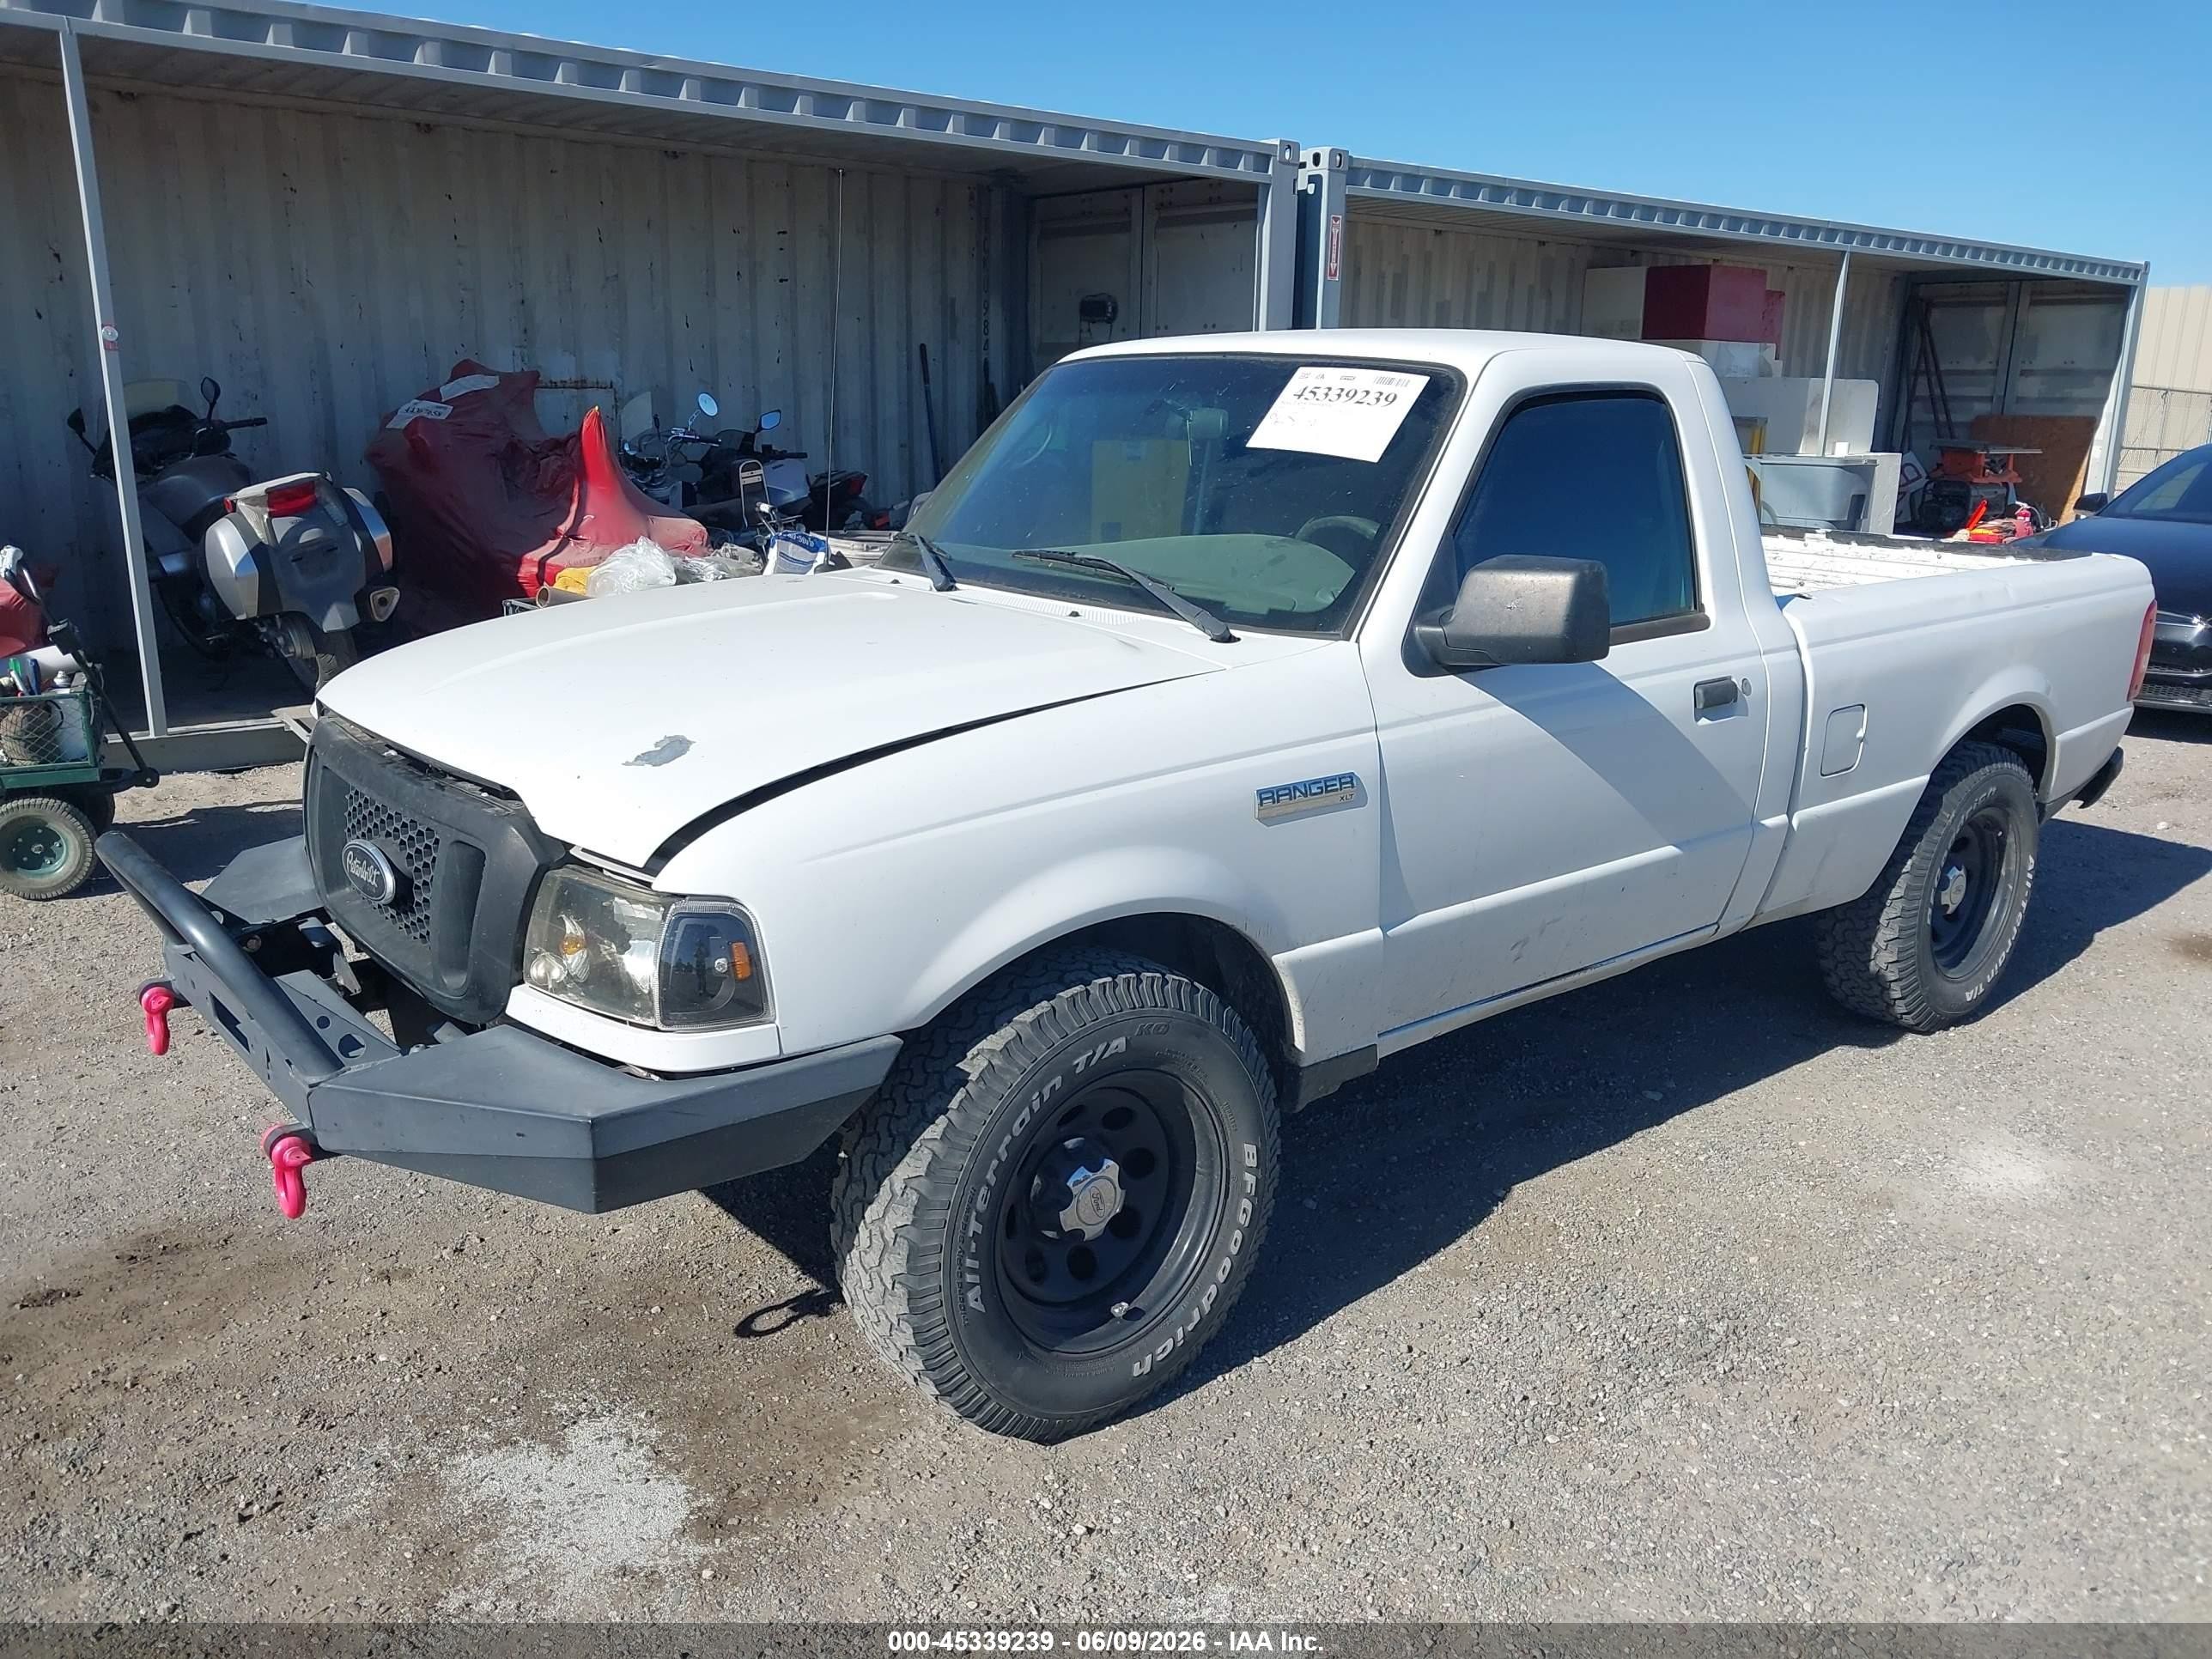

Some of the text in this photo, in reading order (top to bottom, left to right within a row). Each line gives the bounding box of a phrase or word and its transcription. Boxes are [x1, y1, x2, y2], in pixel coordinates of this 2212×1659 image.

[1292, 385, 1398, 408] 45339239
[1258, 774, 1356, 808] RANGER
[1338, 793, 1355, 803] XLT
[346, 850, 380, 888] Peterbilt
[1965, 854, 2035, 1002] All-Terrain T/A
[966, 1075, 1063, 1313] All-Terrain
[1073, 1036, 1127, 1074] T/A
[1133, 1143, 1258, 1378] BFGoodrich
